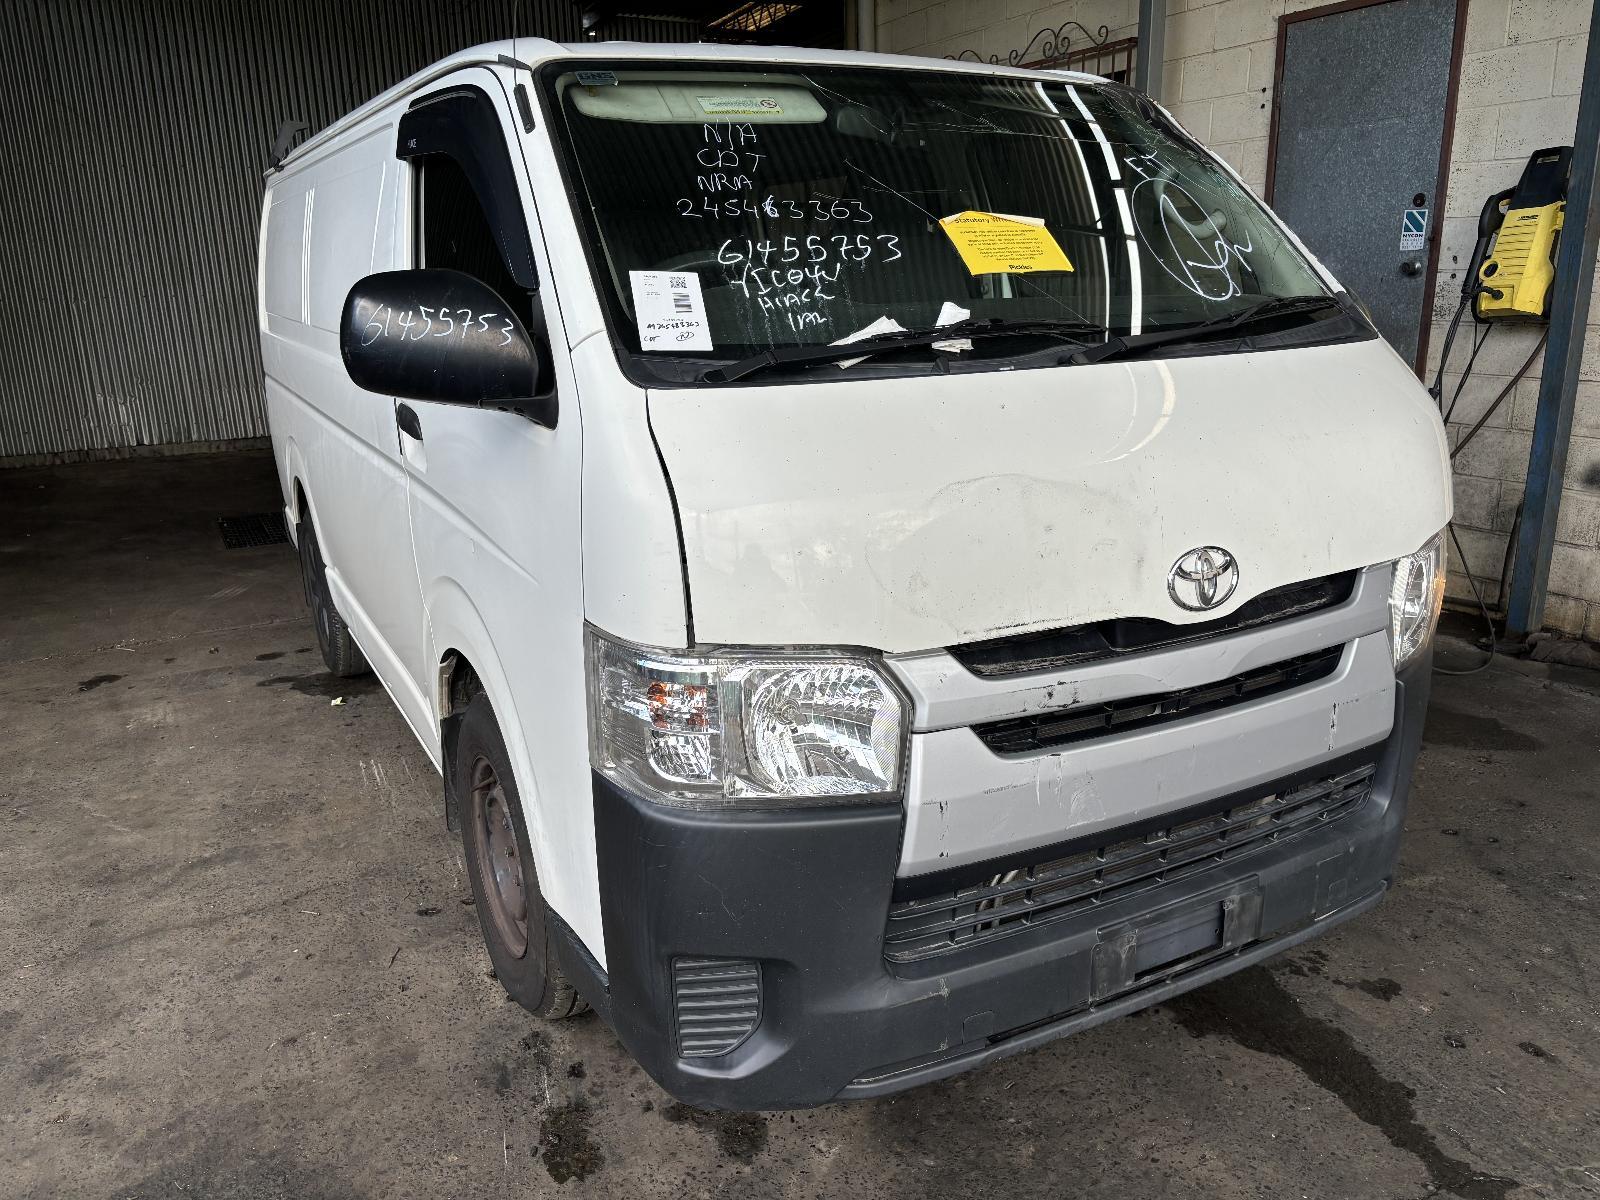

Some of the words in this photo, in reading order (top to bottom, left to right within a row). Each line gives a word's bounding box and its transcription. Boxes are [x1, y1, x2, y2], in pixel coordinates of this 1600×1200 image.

[954, 216, 990, 224] Statutory
[717, 234, 902, 264] 61455753
[361, 303, 514, 346] 61455753
